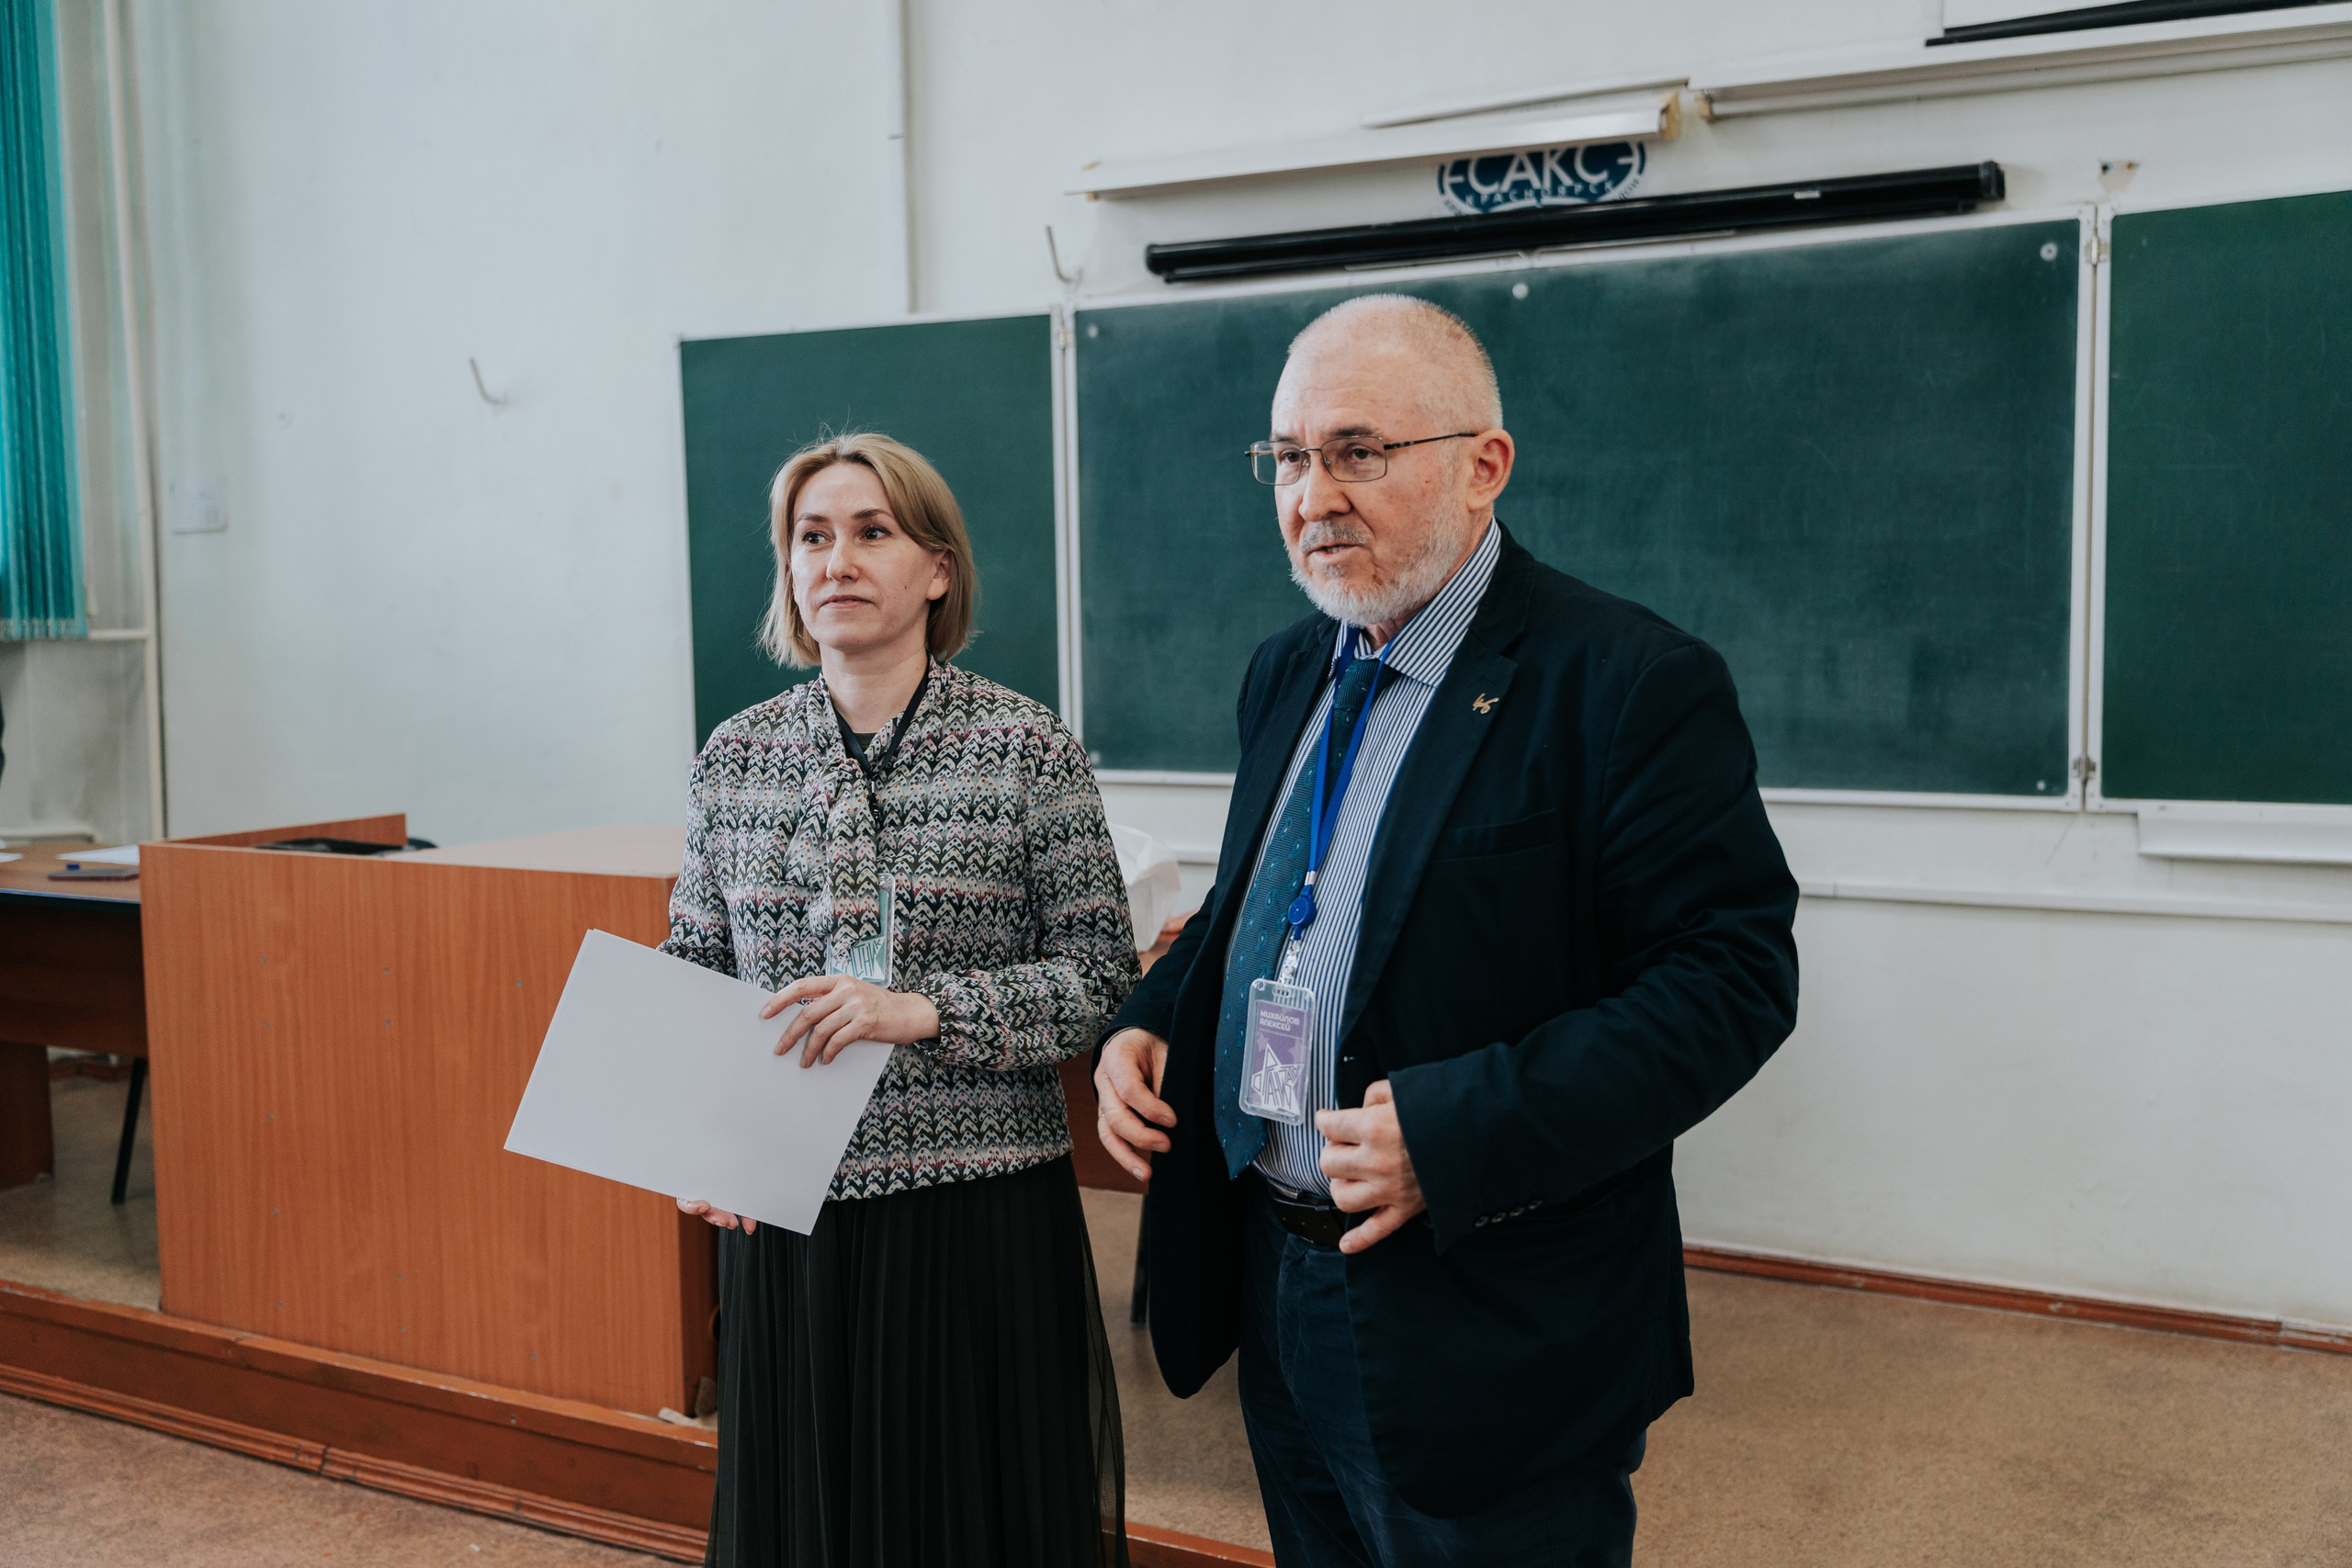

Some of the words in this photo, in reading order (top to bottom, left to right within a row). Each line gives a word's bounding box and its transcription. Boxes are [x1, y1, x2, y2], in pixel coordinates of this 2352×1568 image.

[1464, 179, 1613, 207] КРАСНОЯРСК
[1259, 1018, 1291, 1032] АЛЕКСЕЙ
[1260, 1010, 1300, 1026] МИХАЙЛОВ
